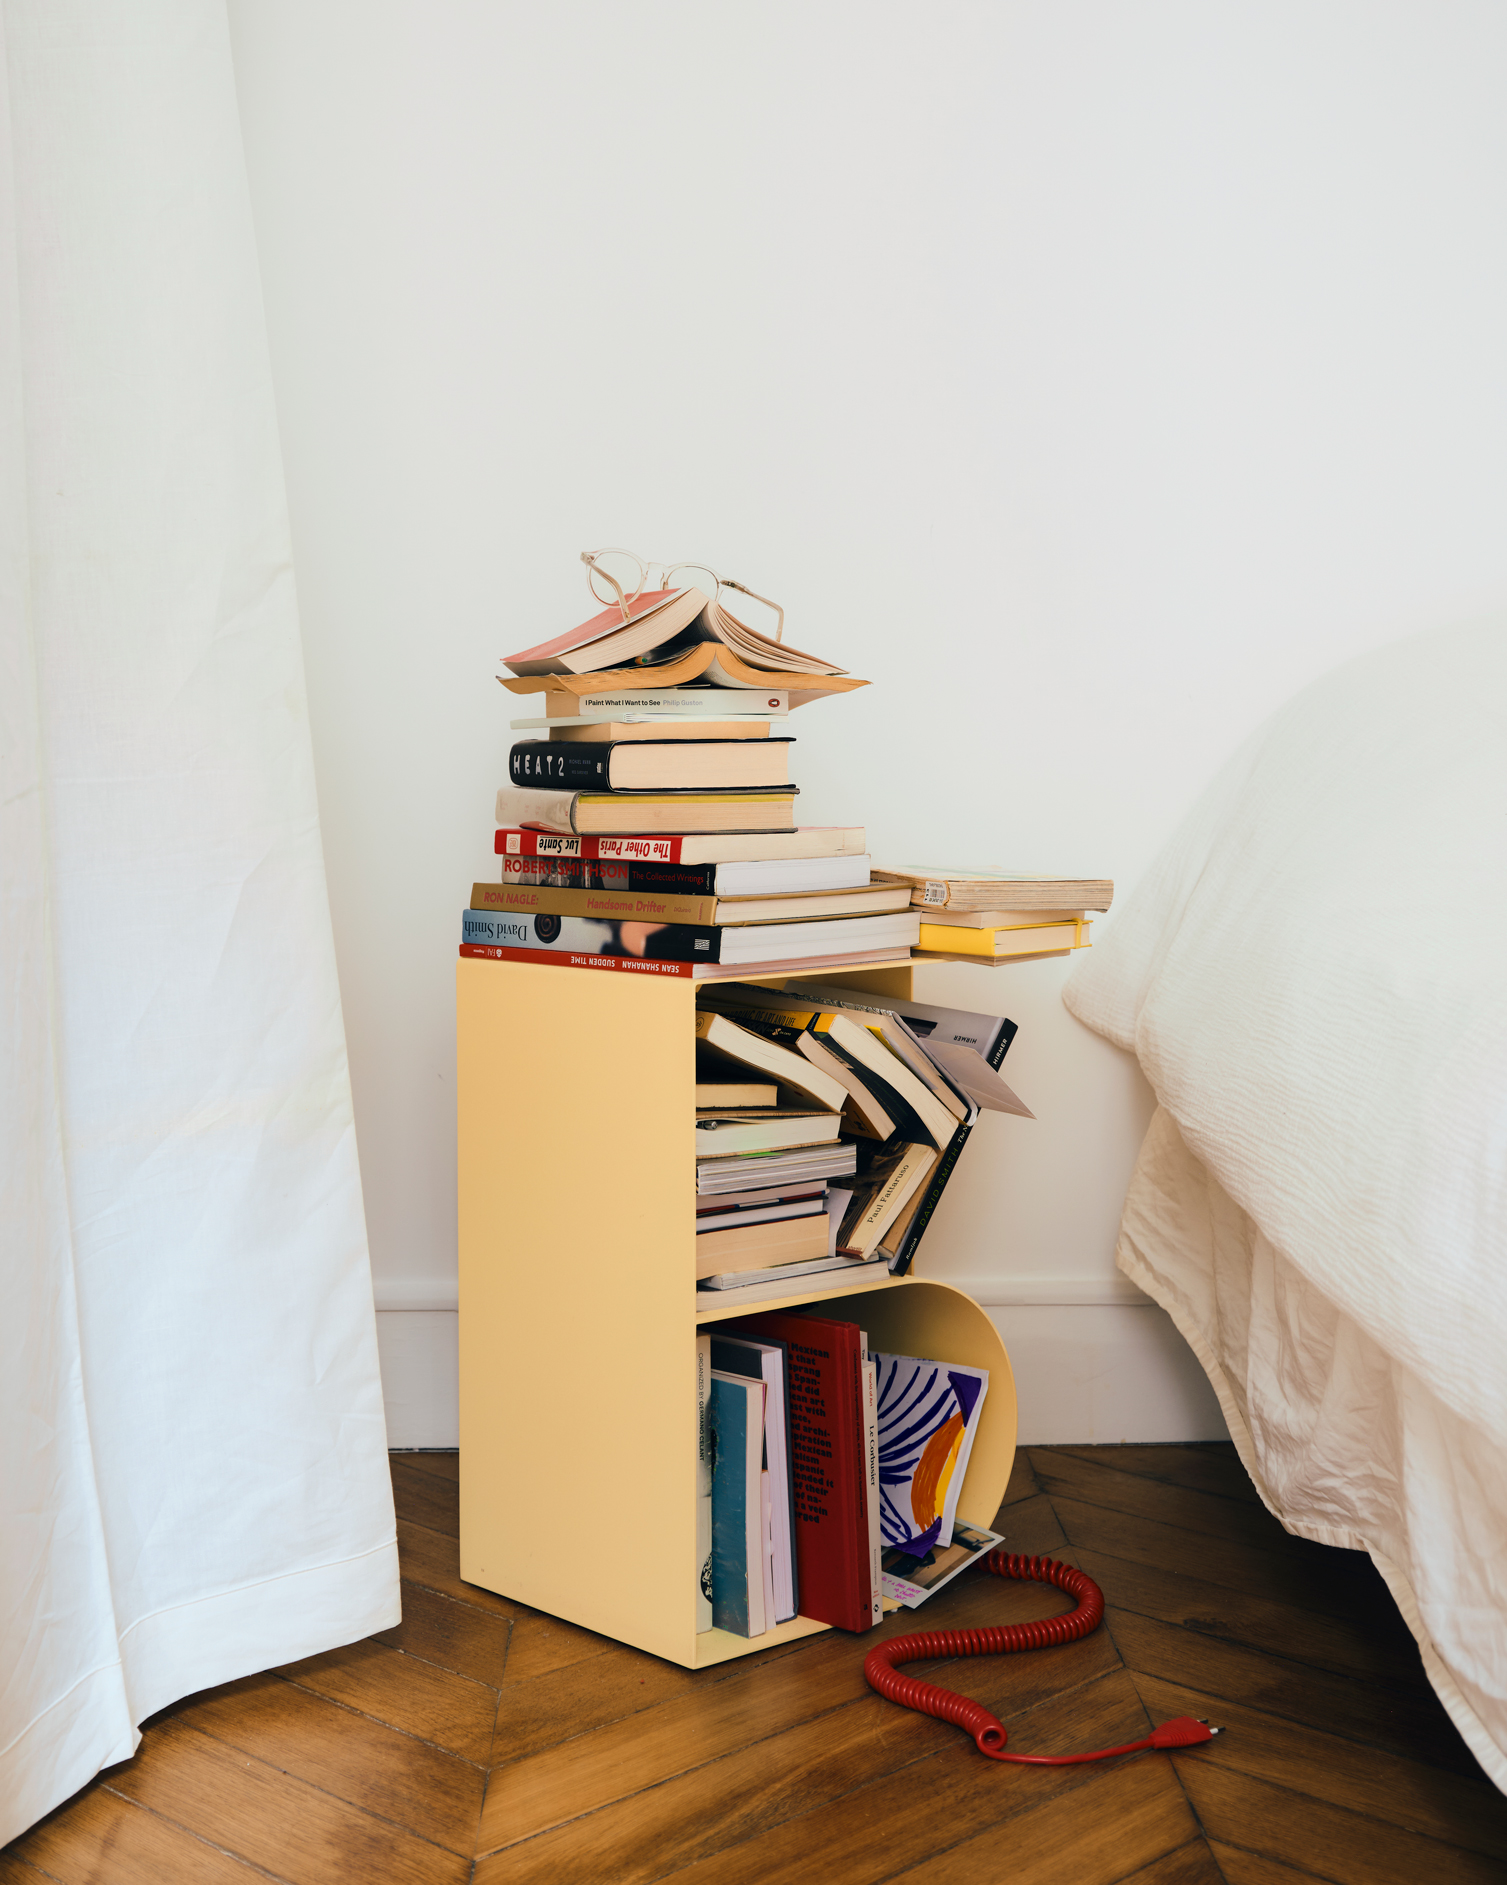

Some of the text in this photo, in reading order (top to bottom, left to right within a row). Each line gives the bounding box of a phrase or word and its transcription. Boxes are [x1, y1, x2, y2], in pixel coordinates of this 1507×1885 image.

[663, 700, 680, 708] Philip
[513, 754, 565, 777] HEAT 2
[539, 838, 580, 855] Luc Sante
[600, 840, 669, 859] The Other Paris
[504, 858, 628, 879] ROBERT SMITHSON
[632, 870, 704, 886] The Collected Writings
[483, 891, 539, 906] RON NAGLE:
[586, 898, 667, 913] Handsome Drifter
[464, 920, 528, 941] David Smith
[570, 955, 616, 968] SUDDEN TIME
[621, 960, 680, 974] SEAN SHANAHAN
[785, 1016, 797, 1027] LIFE
[953, 1034, 978, 1044] HIRMER
[992, 1038, 1008, 1065] HIRMER
[957, 1131, 966, 1144] The
[867, 1164, 909, 1224] Paul Fattaruso
[919, 1147, 958, 1227] DAVID SMITH
[791, 1342, 830, 1359] Mexican
[796, 1354, 816, 1366] that
[788, 1363, 821, 1378] sprang
[794, 1373, 820, 1386] Span-
[699, 1391, 704, 1400] BY
[804, 1385, 820, 1396] did
[810, 1397, 825, 1407] art
[804, 1406, 826, 1417] with
[803, 1425, 831, 1438] archi-
[869, 1425, 875, 1437] Le
[794, 1441, 832, 1459] Mexican
[794, 1481, 829, 1497] of their
[826, 1478, 834, 1489] it
[795, 1491, 822, 1504] of na-
[800, 1502, 806, 1510] a
[808, 1504, 828, 1517] vein
